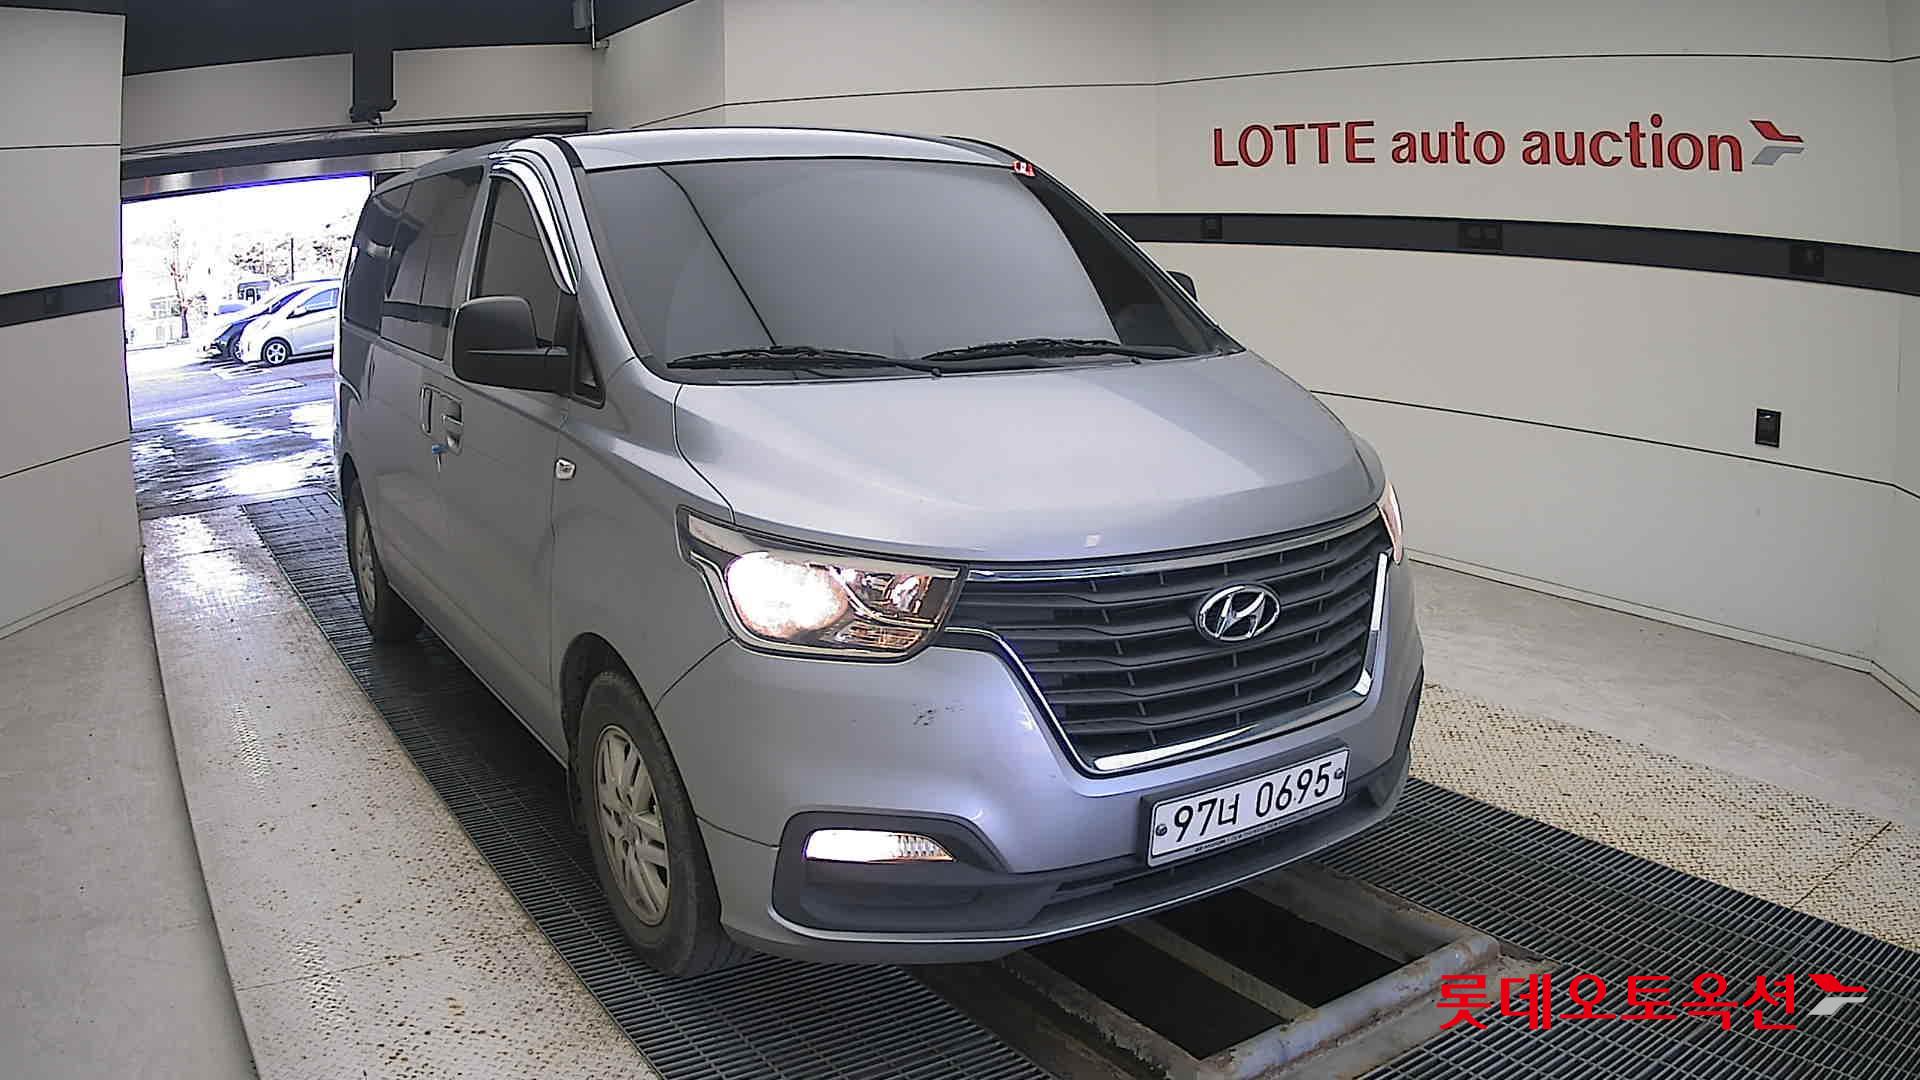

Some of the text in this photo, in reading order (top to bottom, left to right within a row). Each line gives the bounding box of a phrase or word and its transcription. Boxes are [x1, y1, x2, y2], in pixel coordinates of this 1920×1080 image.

[1213, 113, 1745, 173] LOTTE auto auction
[1173, 793, 1241, 843] 97너
[1255, 761, 1333, 818] 0695
